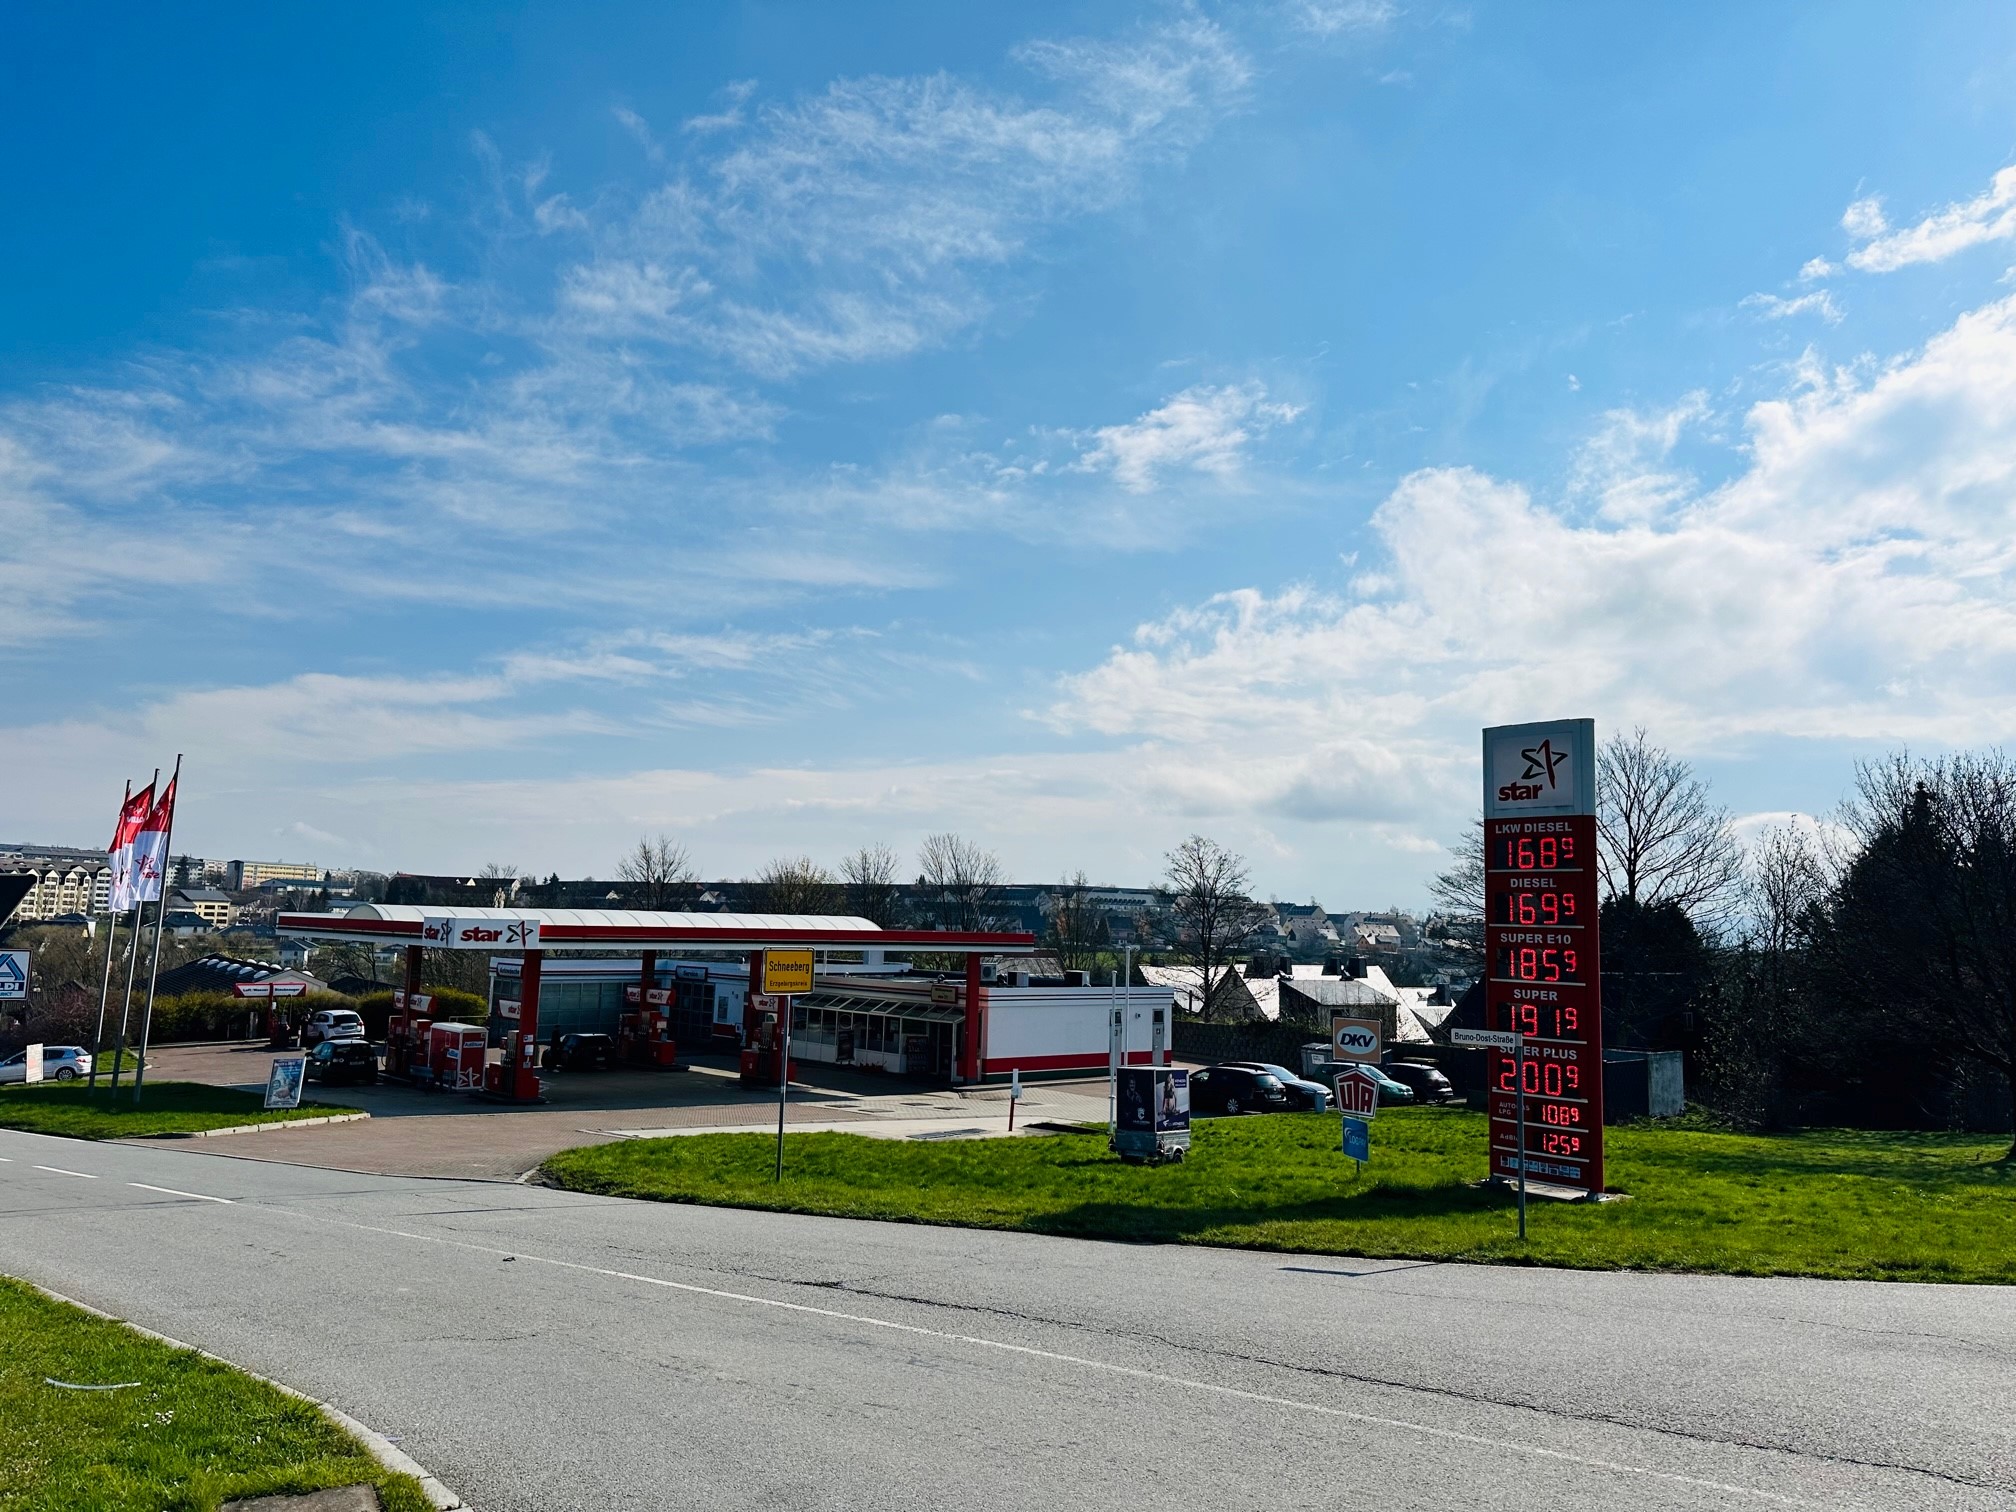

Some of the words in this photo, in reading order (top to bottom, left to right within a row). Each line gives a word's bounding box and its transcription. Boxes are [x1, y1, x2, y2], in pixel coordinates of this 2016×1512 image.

[1498, 781, 1543, 801] star
[1495, 824, 1521, 834] LKW
[1524, 822, 1573, 833] DIESEL
[1508, 837, 1574, 869] 1689
[1510, 878, 1557, 888] DIESEL
[1509, 893, 1575, 925] 1699
[424, 925, 440, 940] star
[460, 926, 503, 942] star
[1500, 932, 1543, 944] SUPER
[1547, 934, 1572, 944] E10
[769, 961, 810, 975] Schneeberg
[1510, 948, 1577, 982] 1859
[1513, 989, 1558, 1001] SUPER
[1340, 1033, 1375, 1048] DKV
[1454, 1032, 1514, 1044] Bruno-Dost-Straße
[1499, 1045, 1540, 1057] SUER
[1543, 1047, 1577, 1060] PLUS
[1500, 1058, 1579, 1096] 2009
[1338, 1073, 1376, 1114] UTA
